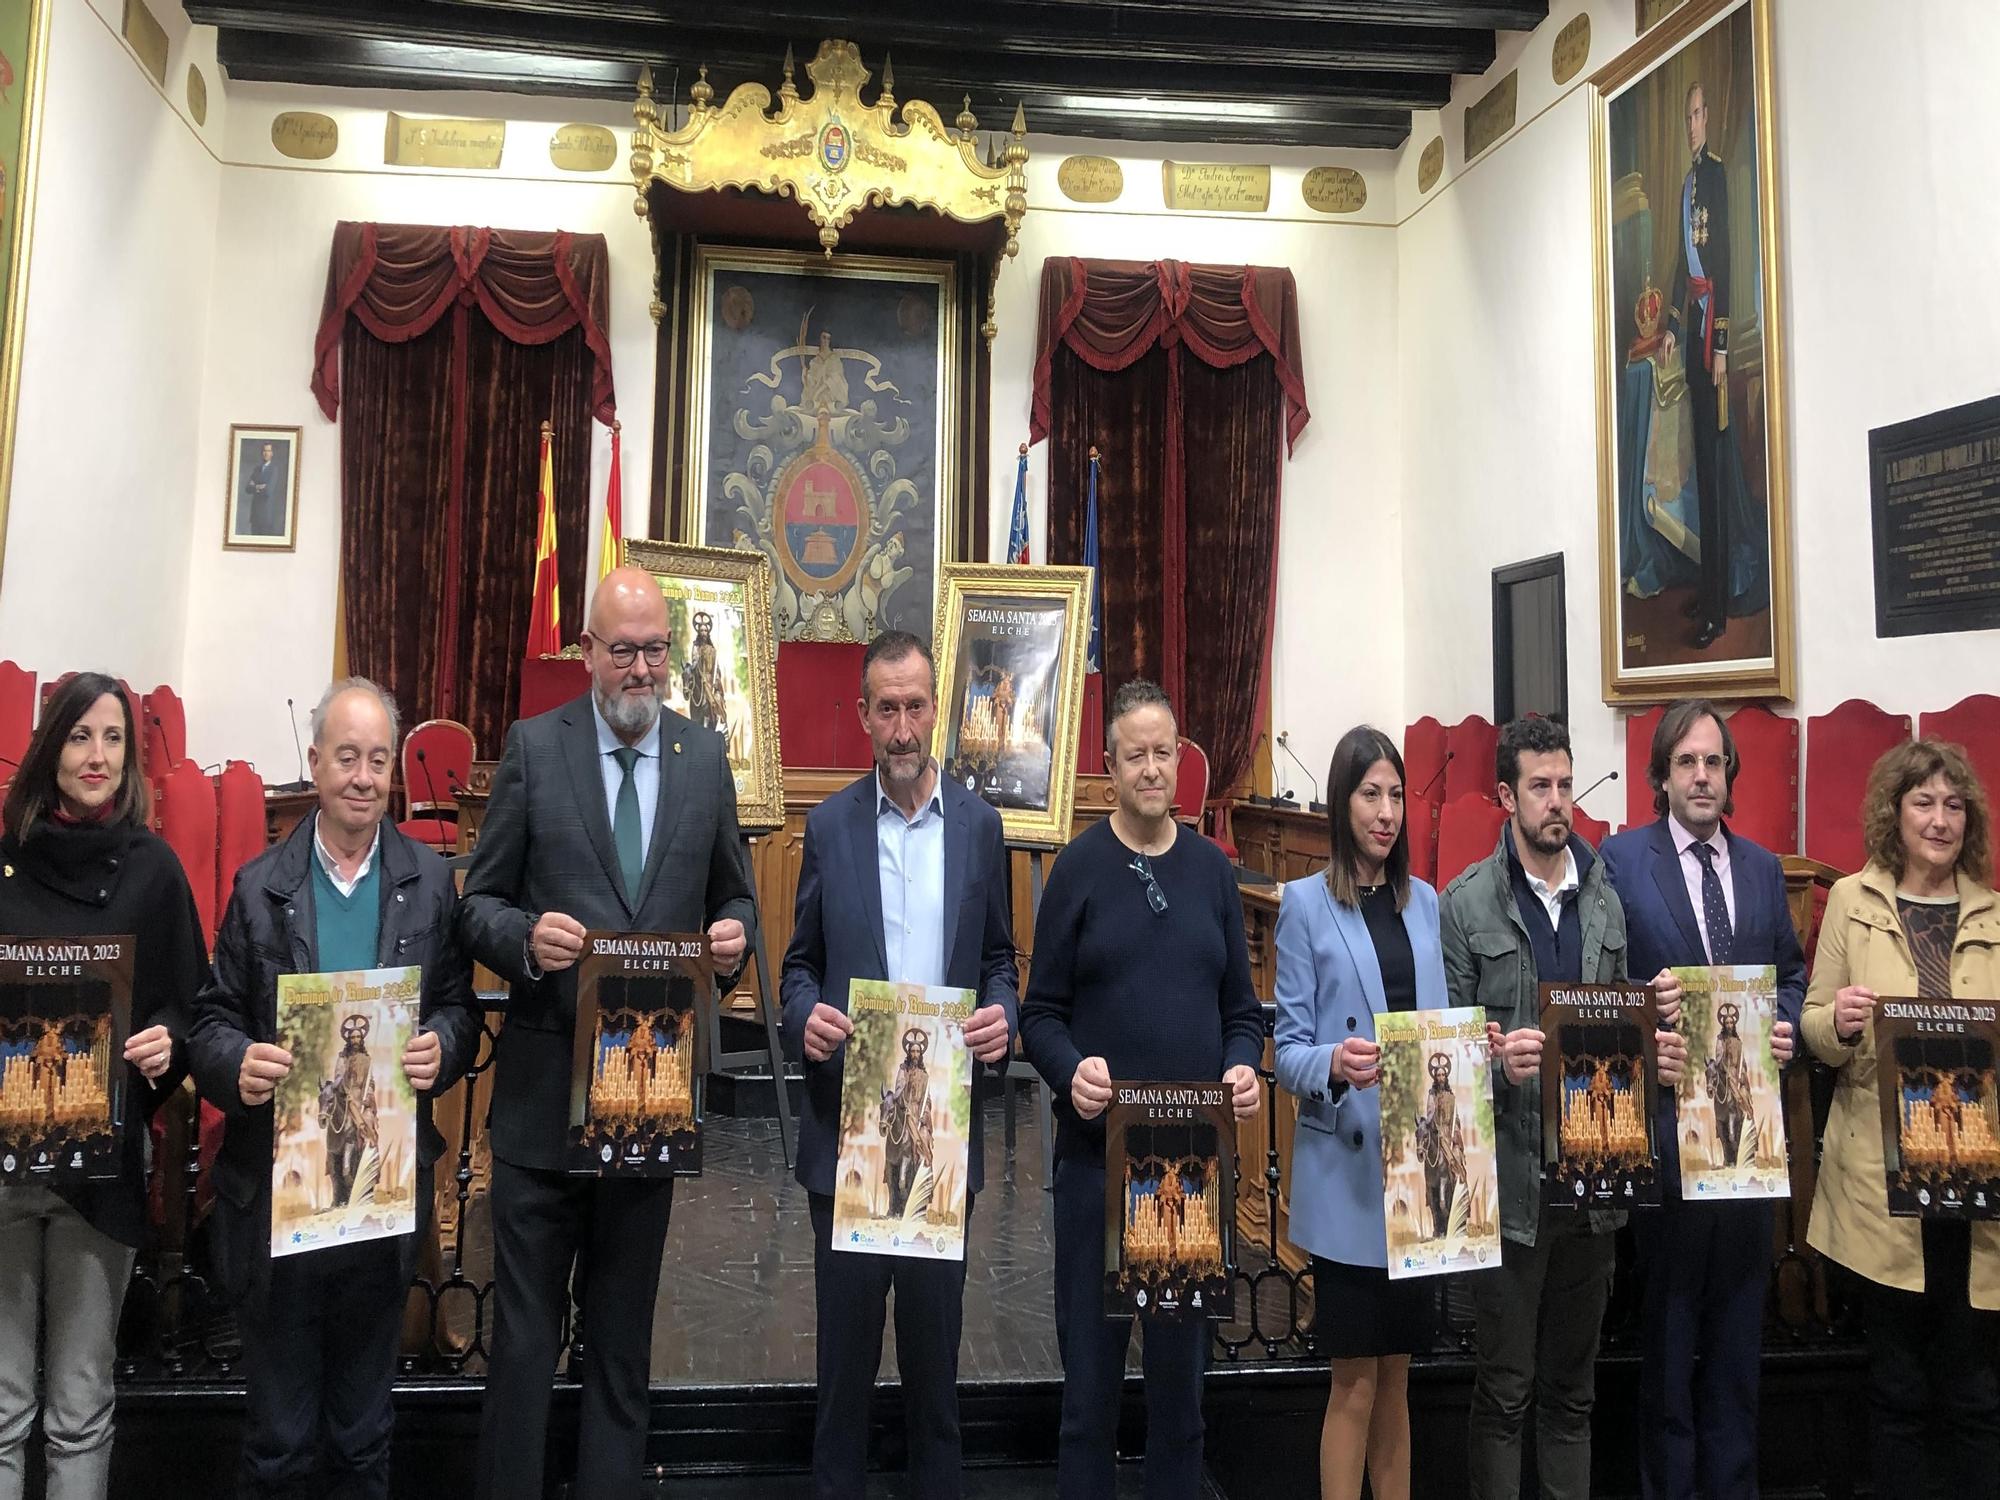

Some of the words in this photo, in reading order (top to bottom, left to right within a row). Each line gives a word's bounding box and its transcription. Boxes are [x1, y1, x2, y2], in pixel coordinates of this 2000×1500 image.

[967, 608, 1005, 624] SEMANA
[1006, 610, 1036, 626] SANTA
[992, 625, 1030, 636] ELCHE
[47, 945, 90, 961] SANTA
[93, 944, 120, 960] 2023
[593, 939, 639, 955] SEMANA
[641, 940, 677, 957] SANTA
[679, 941, 702, 958] 2023
[26, 965, 82, 976] ELCHE
[624, 959, 670, 970] ELCHE
[1747, 977, 1773, 993] 2023
[284, 985, 329, 1007] Domingo
[330, 985, 343, 1004] de
[346, 981, 382, 1003] Ramos
[382, 981, 415, 1001] 2023
[1550, 990, 1591, 1006] SEMANA
[1592, 991, 1624, 1007] SANTA
[1626, 992, 1645, 1007] 2023
[855, 990, 895, 1015] Domingo
[896, 995, 907, 1015] de
[908, 994, 940, 1016] Ramos
[941, 1001, 969, 1019] 2023
[1884, 1002, 1932, 1019] SEMANA
[1933, 1004, 1971, 1020] SANTA
[1972, 1006, 1996, 1022] 2023
[1579, 1009, 1619, 1019] ELCHE
[1381, 1023, 1416, 1043] Domingo
[1428, 1020, 1458, 1040] Ramos
[1459, 1021, 1483, 1037] 2023
[1917, 1021, 1965, 1033] ELCHE
[1118, 1089, 1162, 1104] SEMANA
[1165, 1090, 1199, 1105] SANTA
[1202, 1090, 1223, 1105] 2023
[1149, 1108, 1193, 1118] ELCHE
